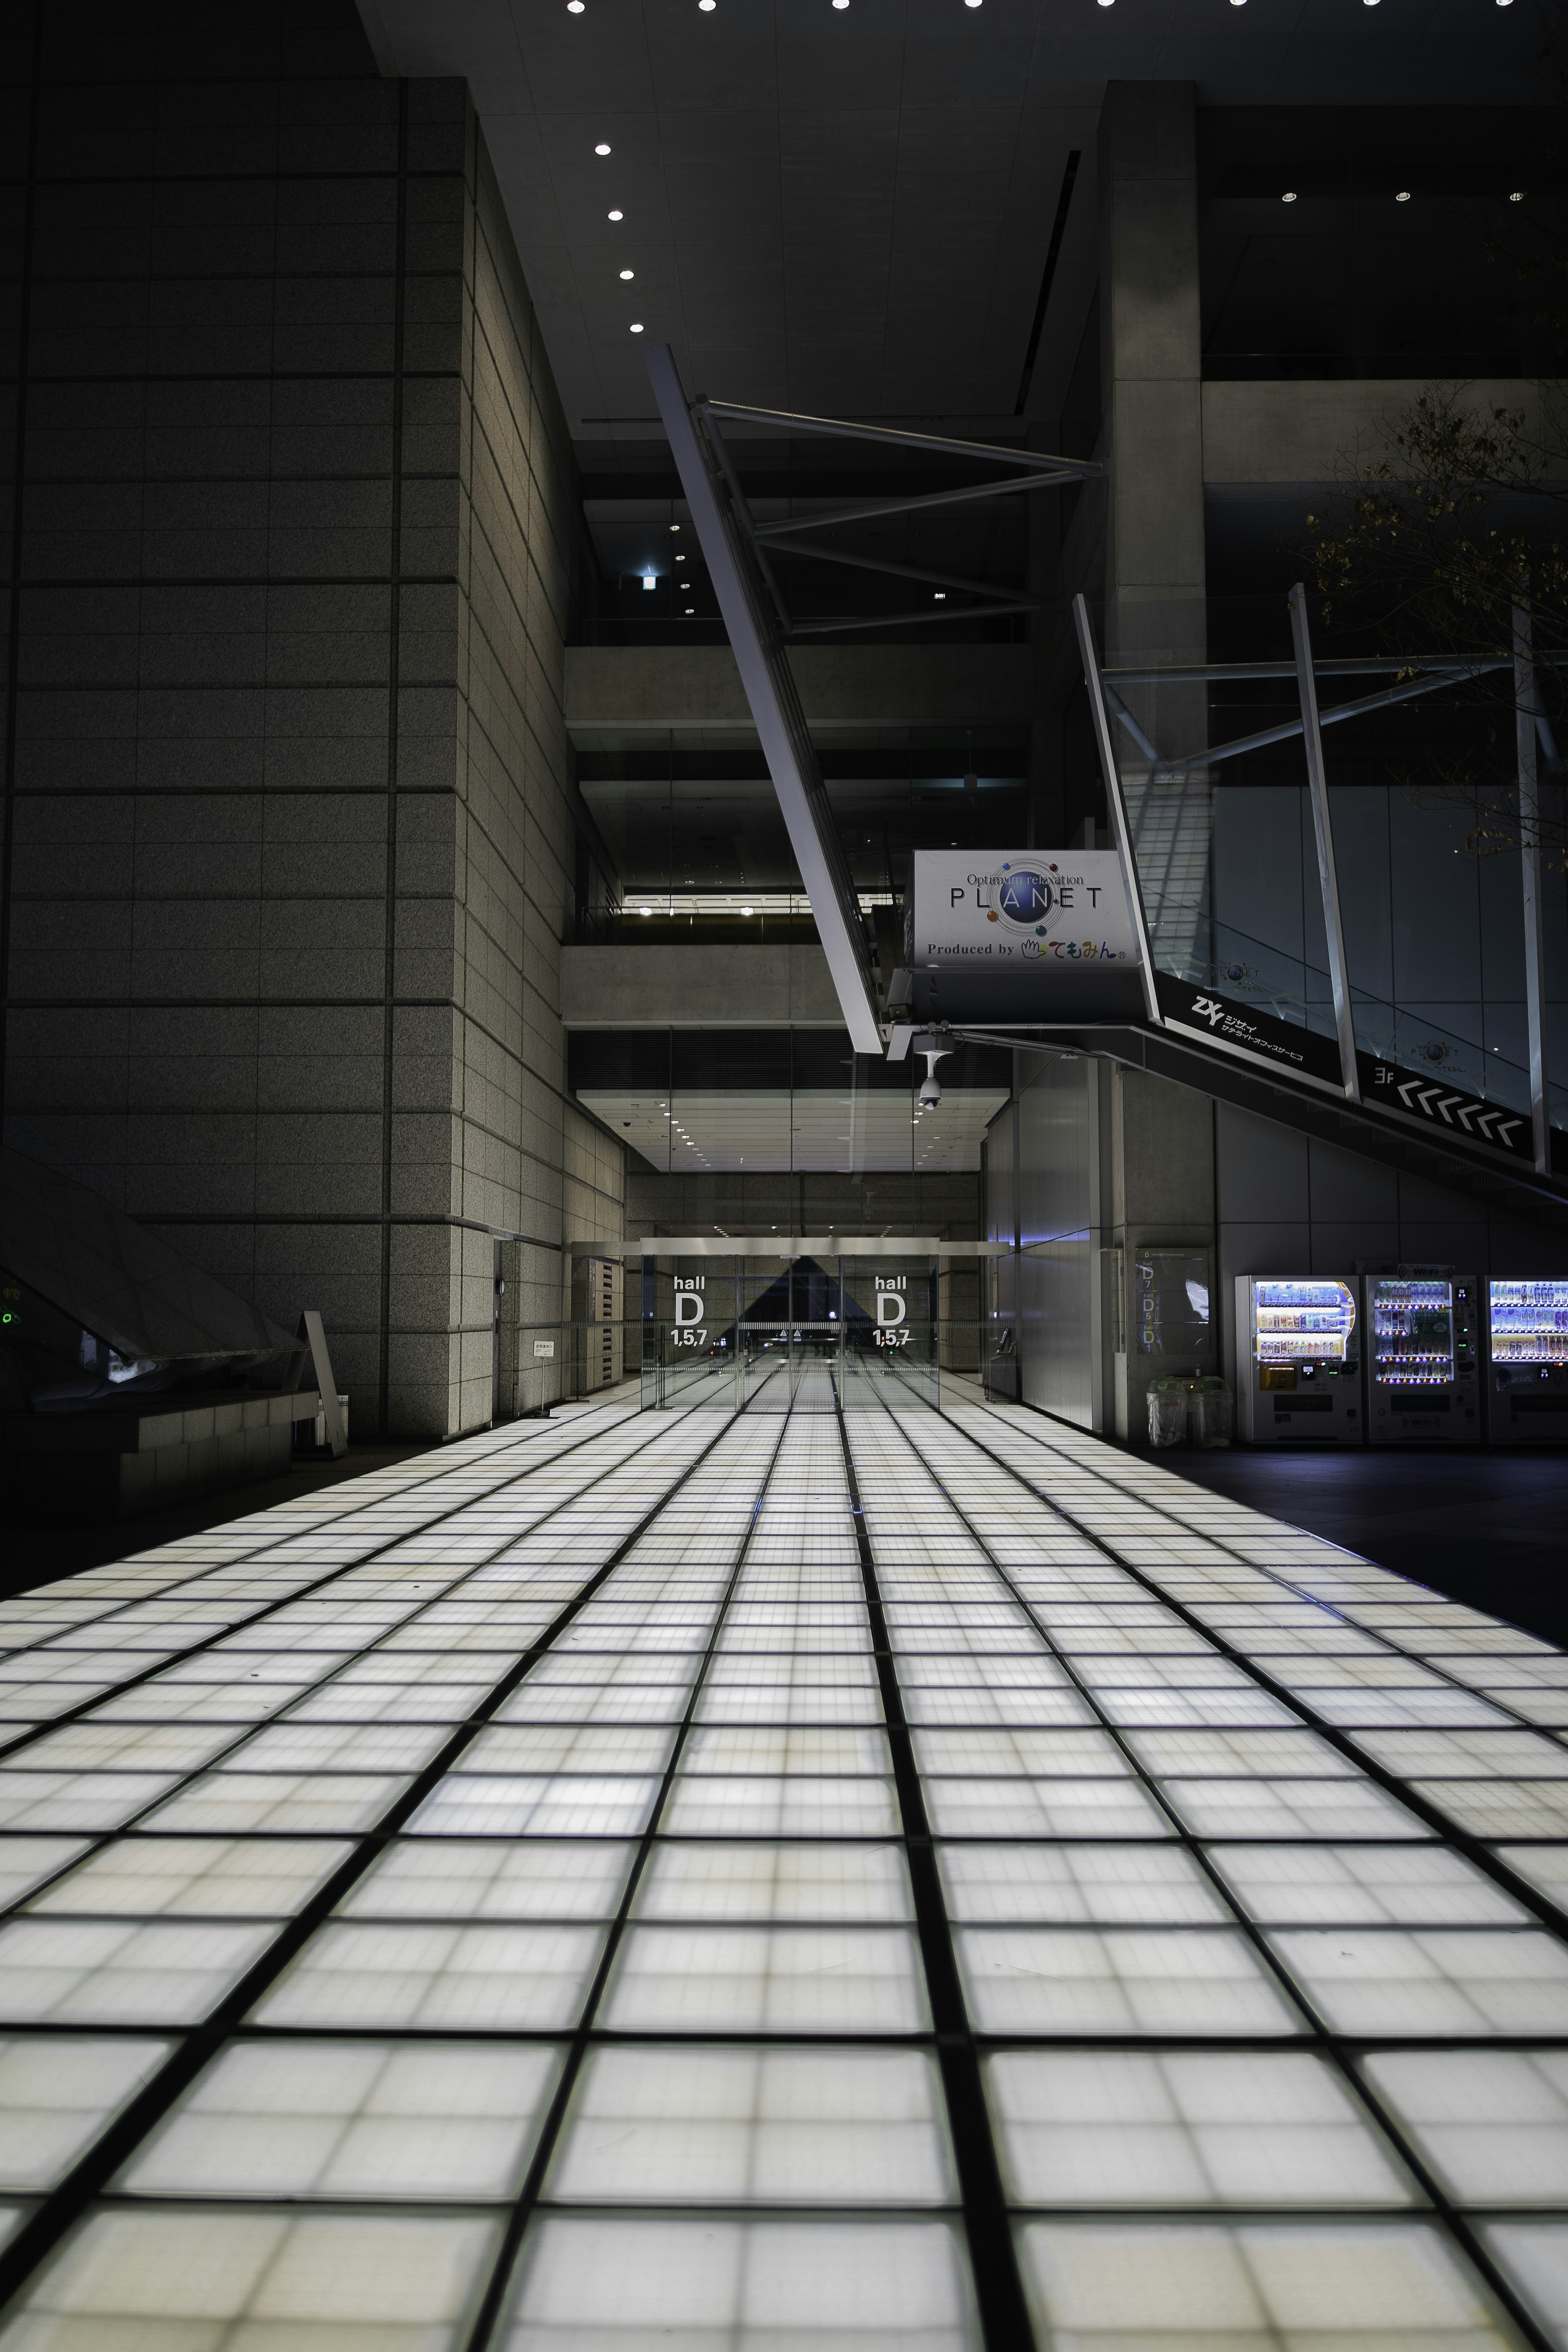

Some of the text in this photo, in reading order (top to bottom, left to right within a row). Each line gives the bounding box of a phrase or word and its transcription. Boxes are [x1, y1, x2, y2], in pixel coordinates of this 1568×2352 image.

[967, 873, 1084, 886] Optimum relaxation
[951, 887, 1102, 908] PLANET
[927, 944, 993, 954] Produced
[999, 944, 1014, 955] by
[1225, 1015, 1257, 1033] ジザイ
[1222, 1025, 1303, 1061] サテライトオフィスサービス
[1143, 1267, 1154, 1279] D
[674, 1276, 705, 1289] hall
[875, 1276, 906, 1289] hall
[675, 1293, 704, 1326] D
[877, 1293, 906, 1326] D
[1143, 1299, 1154, 1311] D
[671, 1329, 707, 1347] 1,5,7
[873, 1329, 910, 1347] 1,5,7
[1144, 1331, 1154, 1343] D
